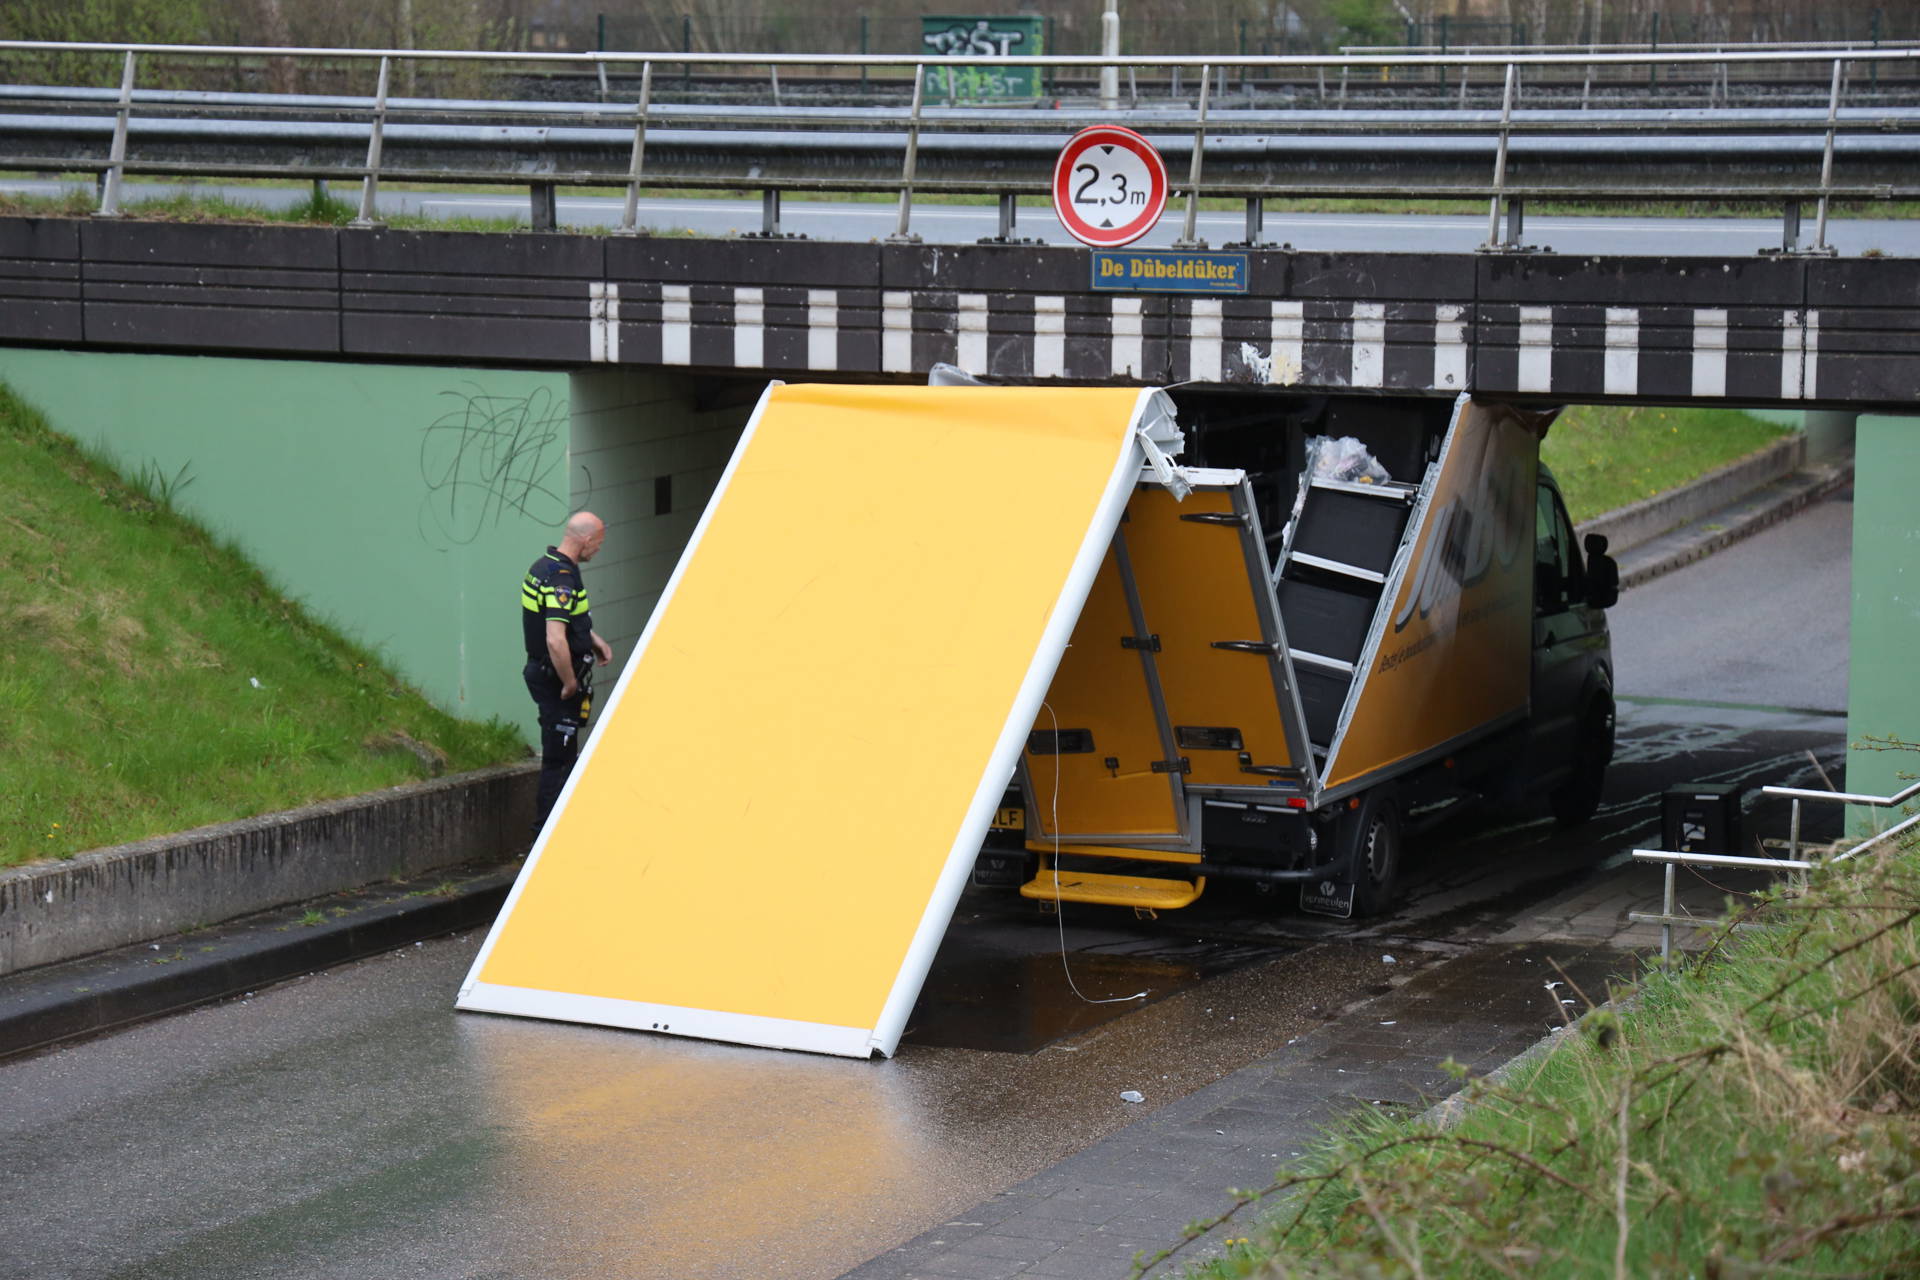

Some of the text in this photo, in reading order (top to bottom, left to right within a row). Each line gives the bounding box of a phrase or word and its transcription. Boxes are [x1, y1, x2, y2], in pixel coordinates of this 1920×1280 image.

[1101, 258, 1237, 279] De Dûbeldûker
[992, 810, 1018, 826] LF
